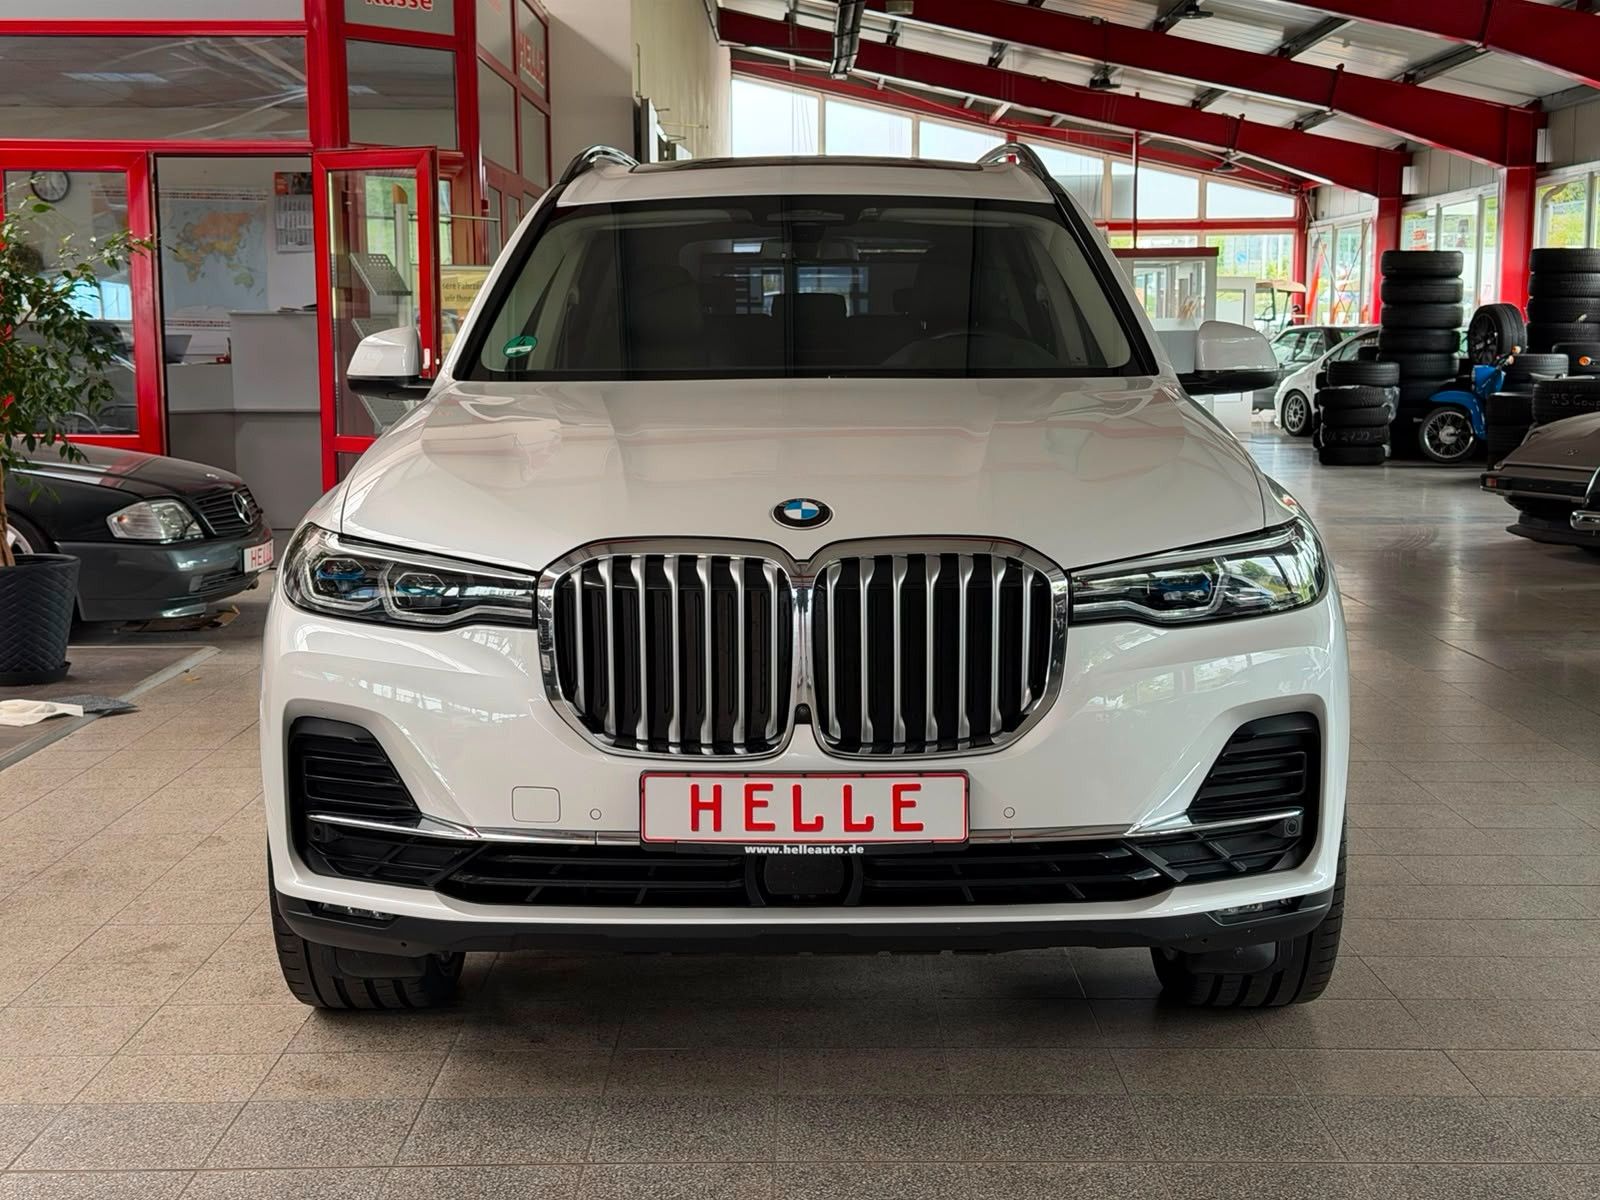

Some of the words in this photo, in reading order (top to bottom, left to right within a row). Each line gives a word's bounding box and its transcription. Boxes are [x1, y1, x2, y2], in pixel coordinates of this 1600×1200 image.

[365, 0, 433, 11] asse
[690, 783, 924, 833] HELLE
[744, 843, 865, 855] www.helleauto.de
